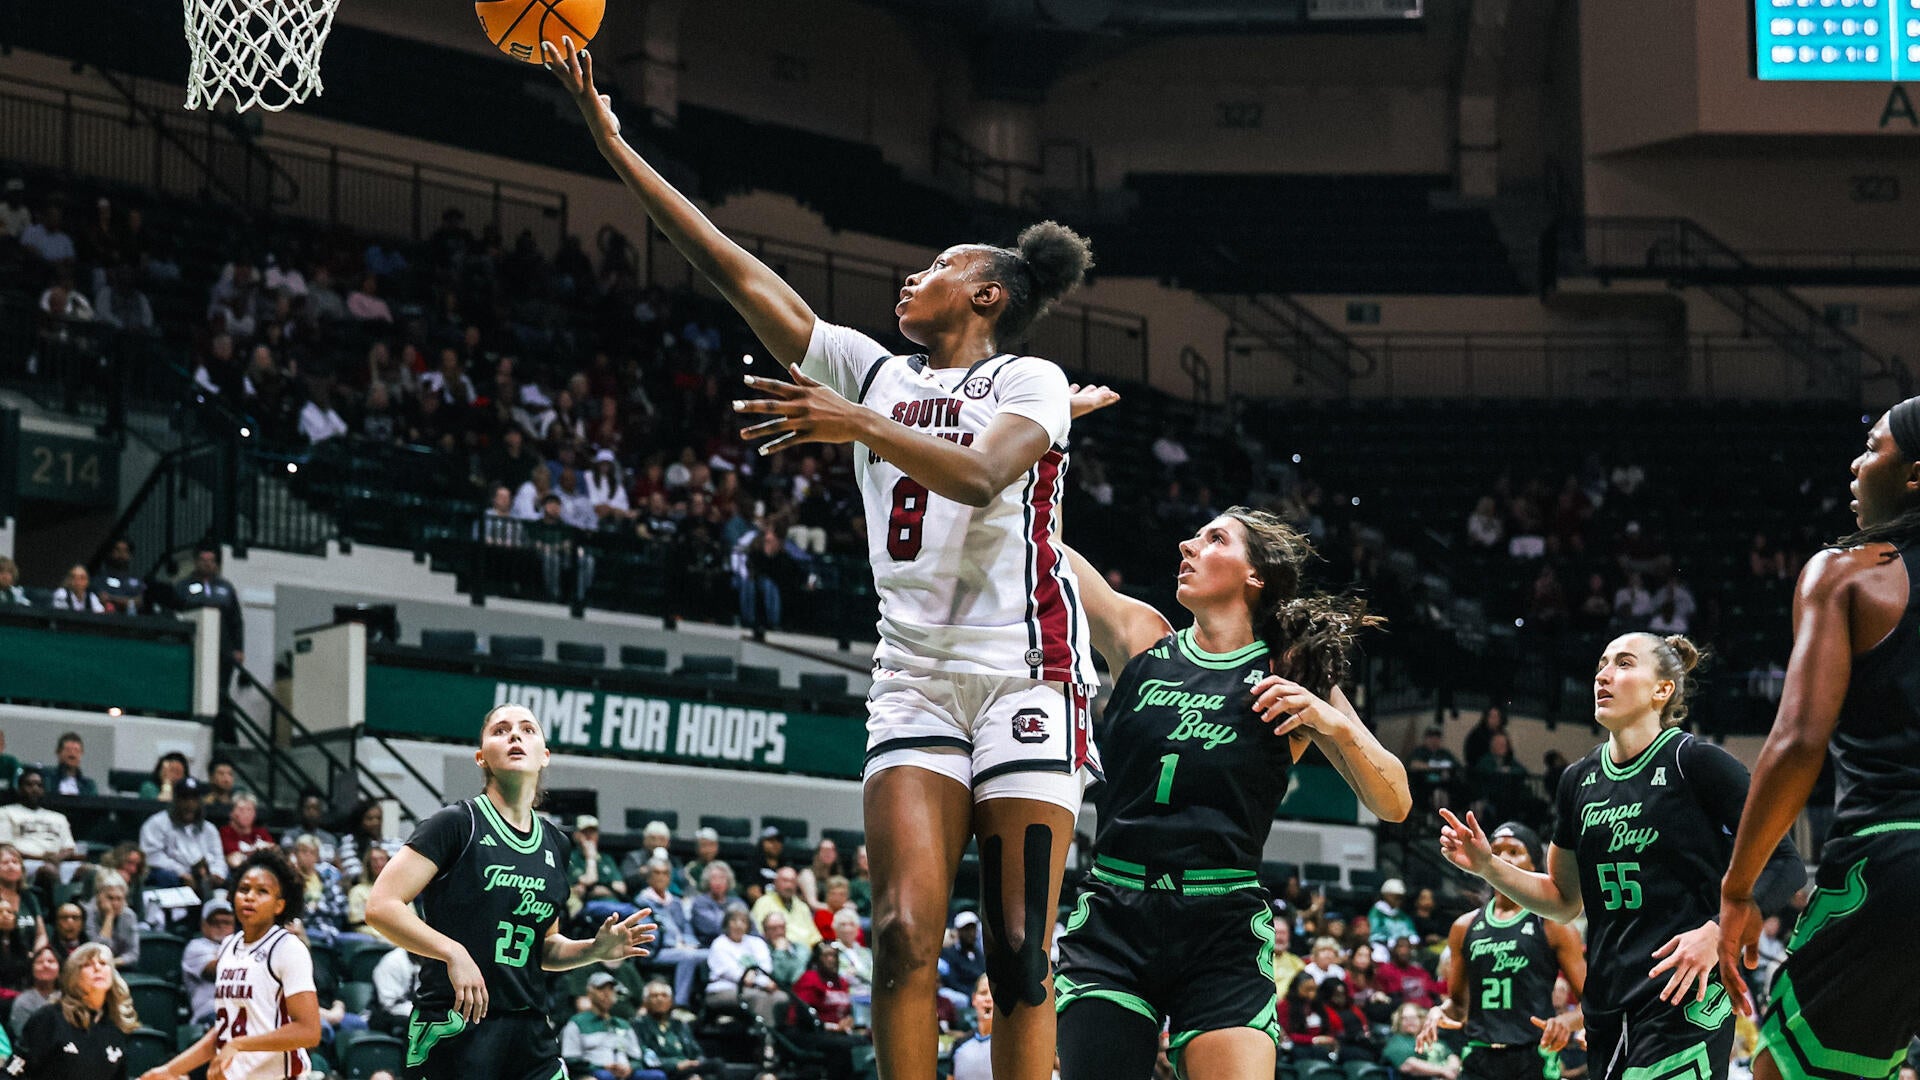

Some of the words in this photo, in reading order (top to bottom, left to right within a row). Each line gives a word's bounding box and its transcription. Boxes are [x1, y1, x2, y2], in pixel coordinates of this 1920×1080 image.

[966, 378, 992, 397] SEC
[891, 398, 964, 428] SOUTH
[32, 447, 100, 489] 214
[887, 477, 929, 561] 8
[1133, 679, 1226, 714] Tampa
[600, 694, 670, 754] FOR
[675, 702, 788, 765] HOOPS
[1167, 710, 1238, 750] Bay
[1155, 753, 1180, 805] 1
[1581, 798, 1643, 836] Tampa
[1608, 821, 1660, 854] Bay
[483, 864, 546, 894] Tampa
[1597, 861, 1643, 910] 55
[512, 890, 555, 923] Bay
[494, 920, 536, 968] 23
[1469, 937, 1518, 961] Tampa
[1491, 951, 1530, 974] Bay
[1481, 976, 1513, 1010] 21
[215, 1007, 248, 1051] 24
